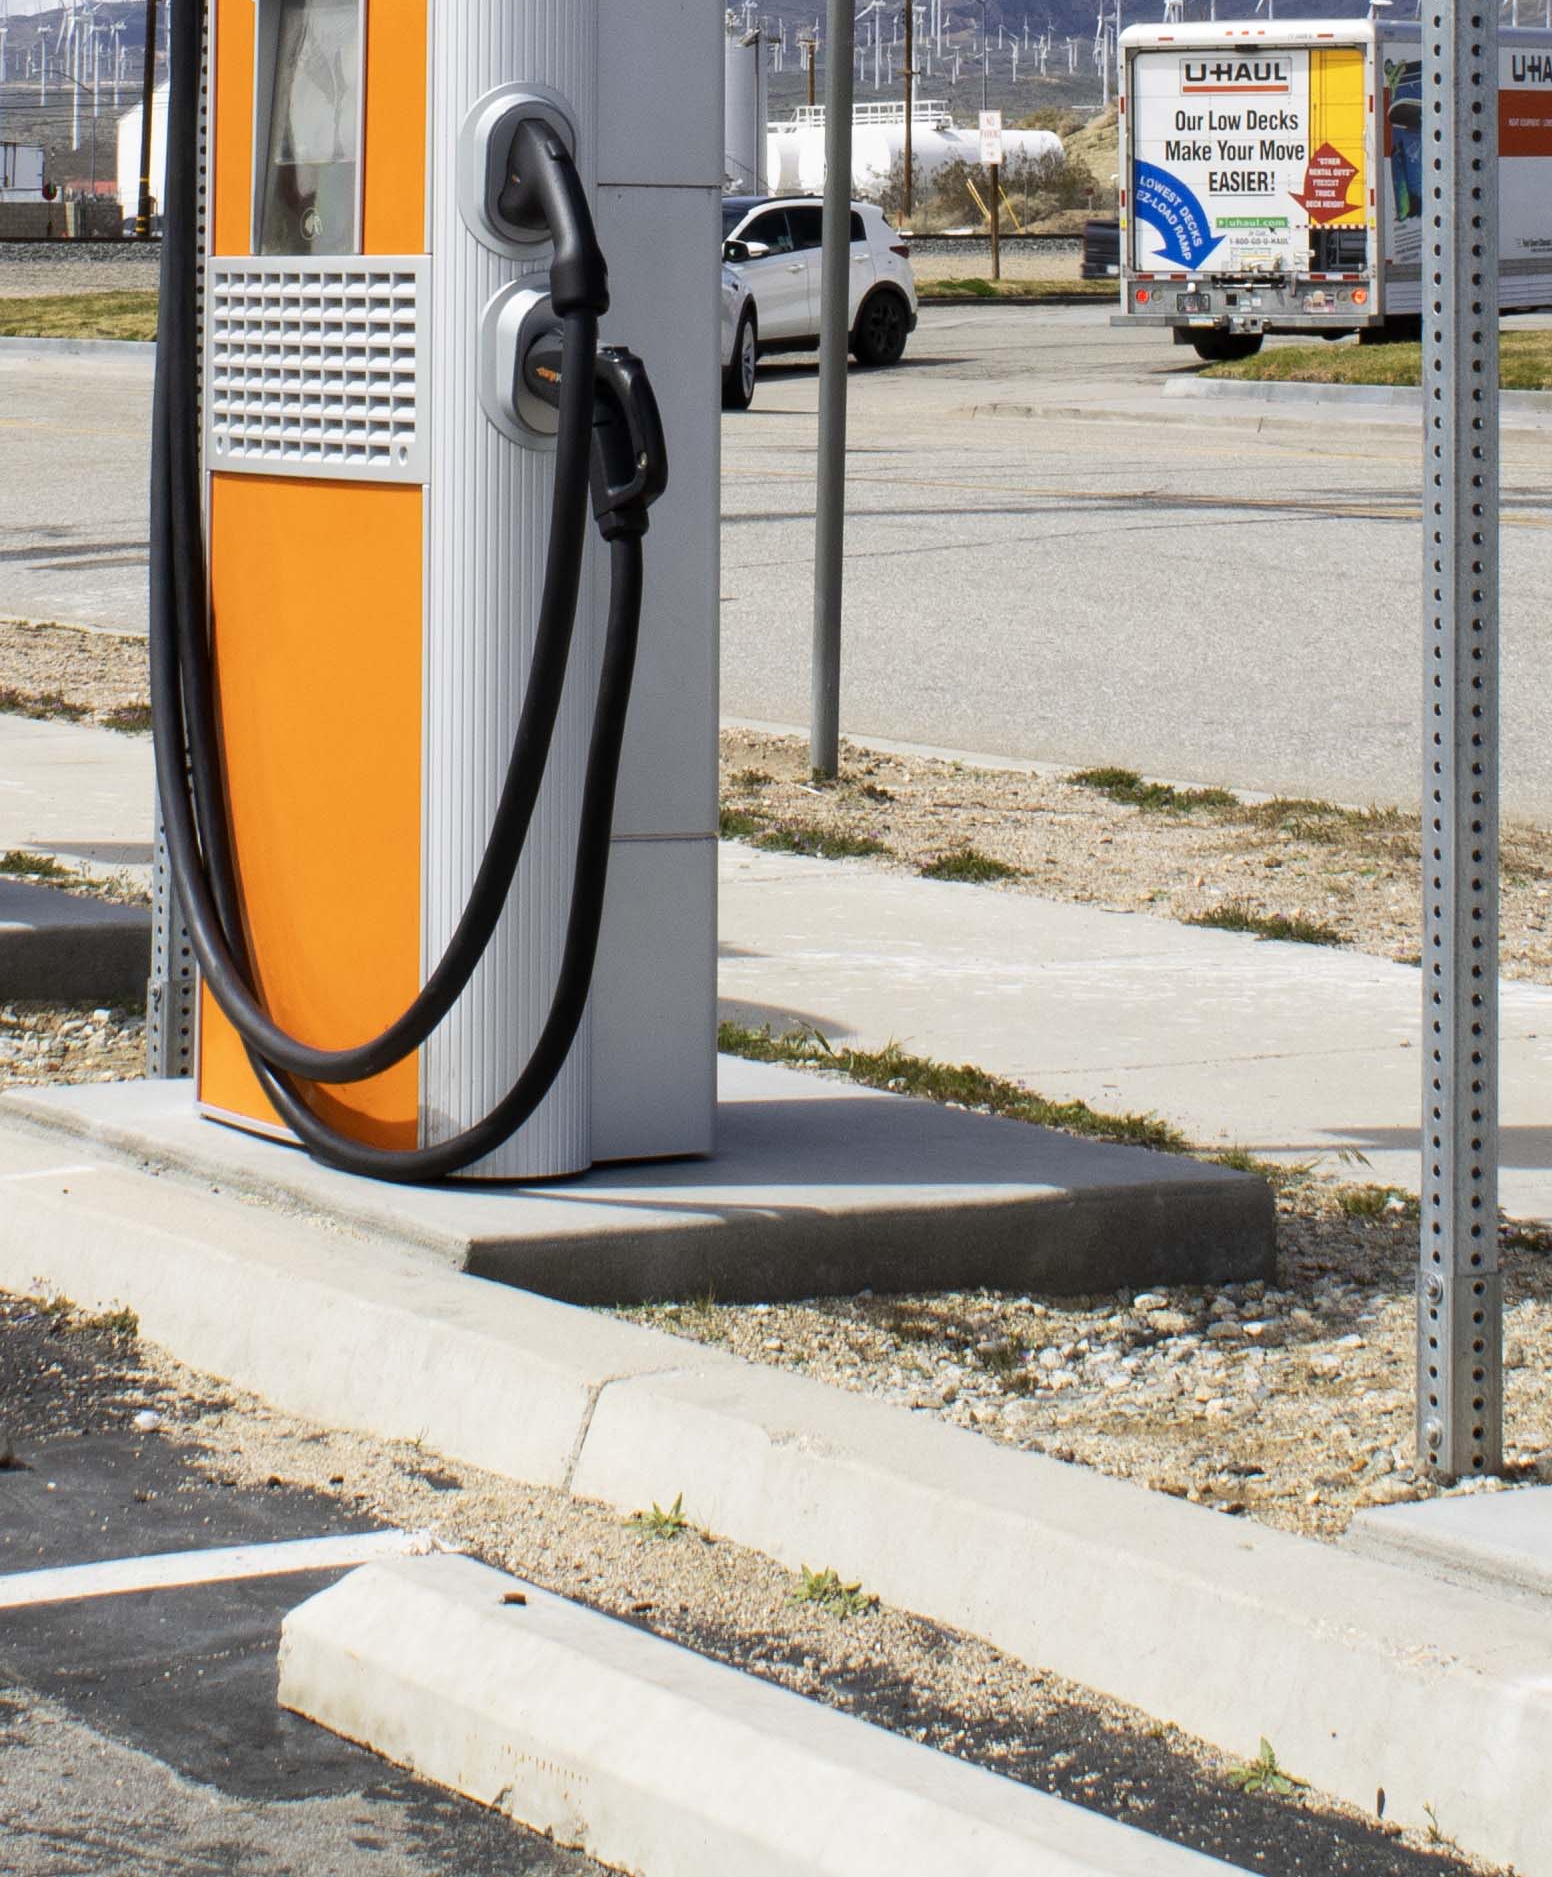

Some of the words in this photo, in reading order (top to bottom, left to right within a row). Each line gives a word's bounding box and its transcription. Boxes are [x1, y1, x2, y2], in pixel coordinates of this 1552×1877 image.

[1185, 62, 1288, 82] U-HAUL
[1175, 110, 1203, 131] Our
[1209, 110, 1241, 131] Low
[1247, 109, 1299, 131] Decks
[1165, 140, 1212, 161] Make
[1218, 140, 1254, 161] Your
[1260, 140, 1305, 161] Move
[1209, 171, 1275, 192] EASIER!
[1140, 175, 1183, 207] LOWEST
[1179, 206, 1203, 248] DECKS
[1136, 190, 1178, 225] EZ-LOAD
[1174, 225, 1192, 260] RAMP
[1230, 218, 1286, 227] uhaul.com
